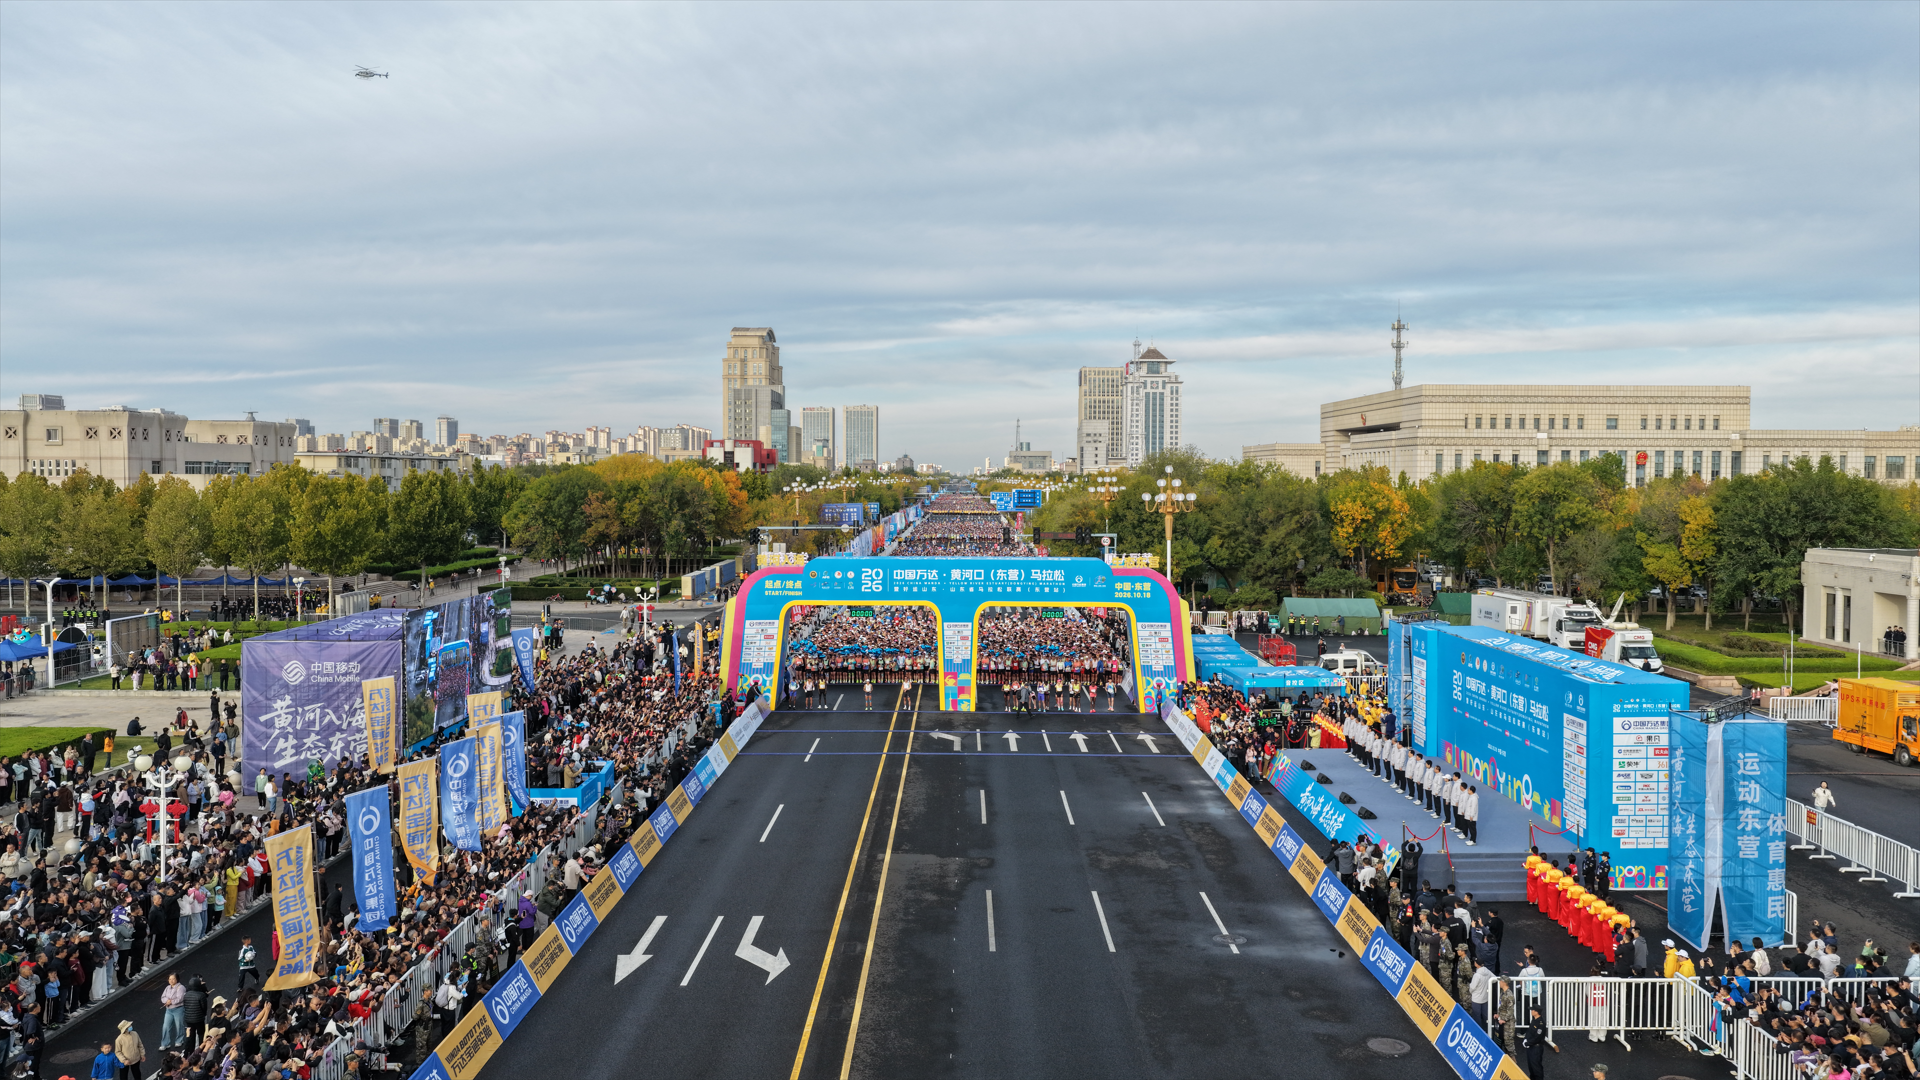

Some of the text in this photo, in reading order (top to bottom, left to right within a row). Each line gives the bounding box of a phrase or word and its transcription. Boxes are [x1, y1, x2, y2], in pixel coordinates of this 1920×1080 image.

[862, 568, 883, 580] 20
[1111, 556, 1160, 568] 生态东营
[765, 580, 802, 589] 起点/终点
[862, 580, 882, 592] 26
[1114, 582, 1151, 590] 中国·东营
[1588, 641, 1598, 650] CMG
[311, 662, 360, 674] 中国移动
[1453, 670, 1462, 686] 20
[1453, 684, 1462, 701] 26
[259, 695, 369, 733] 黄河入海
[262, 730, 370, 769] 生态东营
[1670, 746, 1686, 838] 黄河入海
[1736, 752, 1761, 859] 运动东营
[1284, 834, 1298, 857] 中国万达
[1682, 812, 1704, 913] 生态东营
[1766, 812, 1786, 919] 体育惠民
[1326, 882, 1345, 908] 中国万达
[568, 902, 588, 929] 中国万达
[1380, 946, 1406, 977] 中国万达
[502, 973, 528, 1007] 中国万达
[1405, 982, 1442, 1028] 万达宝通轮胎
[451, 1024, 492, 1078] 万达宝通轮胎
[1460, 1030, 1494, 1072] 中国万达
